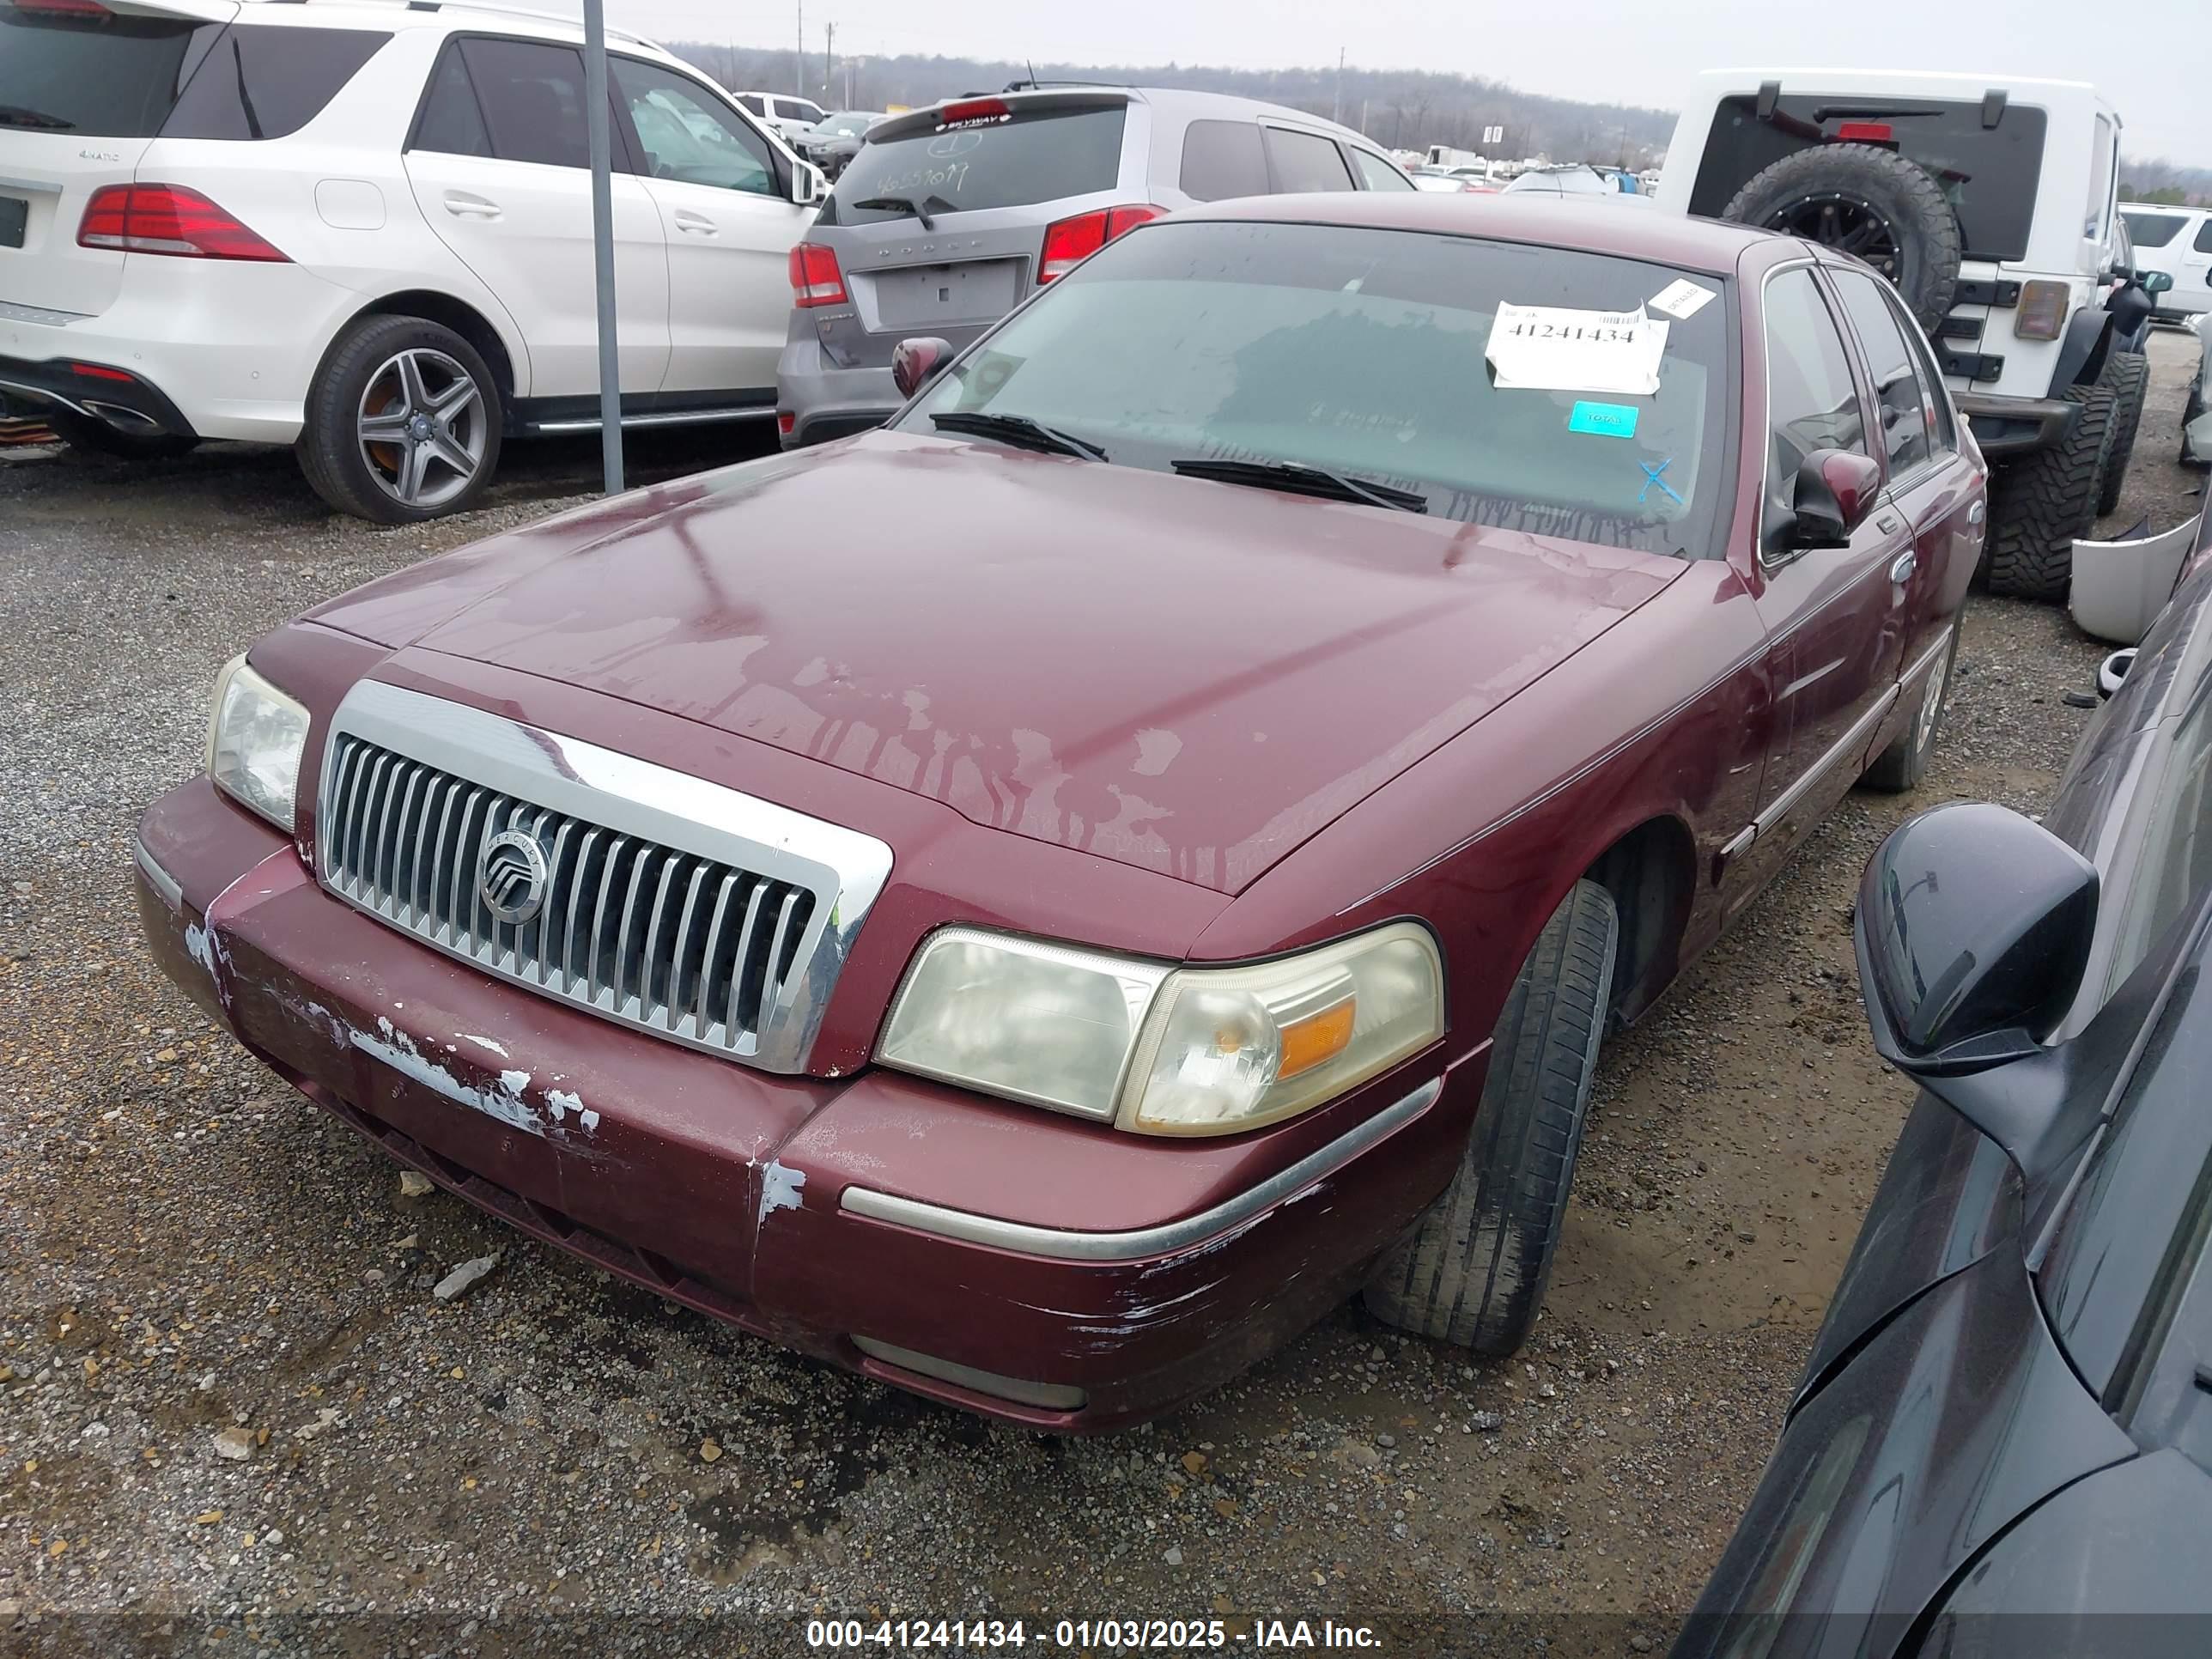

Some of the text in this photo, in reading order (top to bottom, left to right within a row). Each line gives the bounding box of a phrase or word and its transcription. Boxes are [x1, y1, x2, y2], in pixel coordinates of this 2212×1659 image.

[78, 149, 120, 162] 4MATIC
[878, 240, 983, 258] DODGE
[1508, 323, 1635, 343] 41241434
[488, 833, 539, 866] MERCURY
